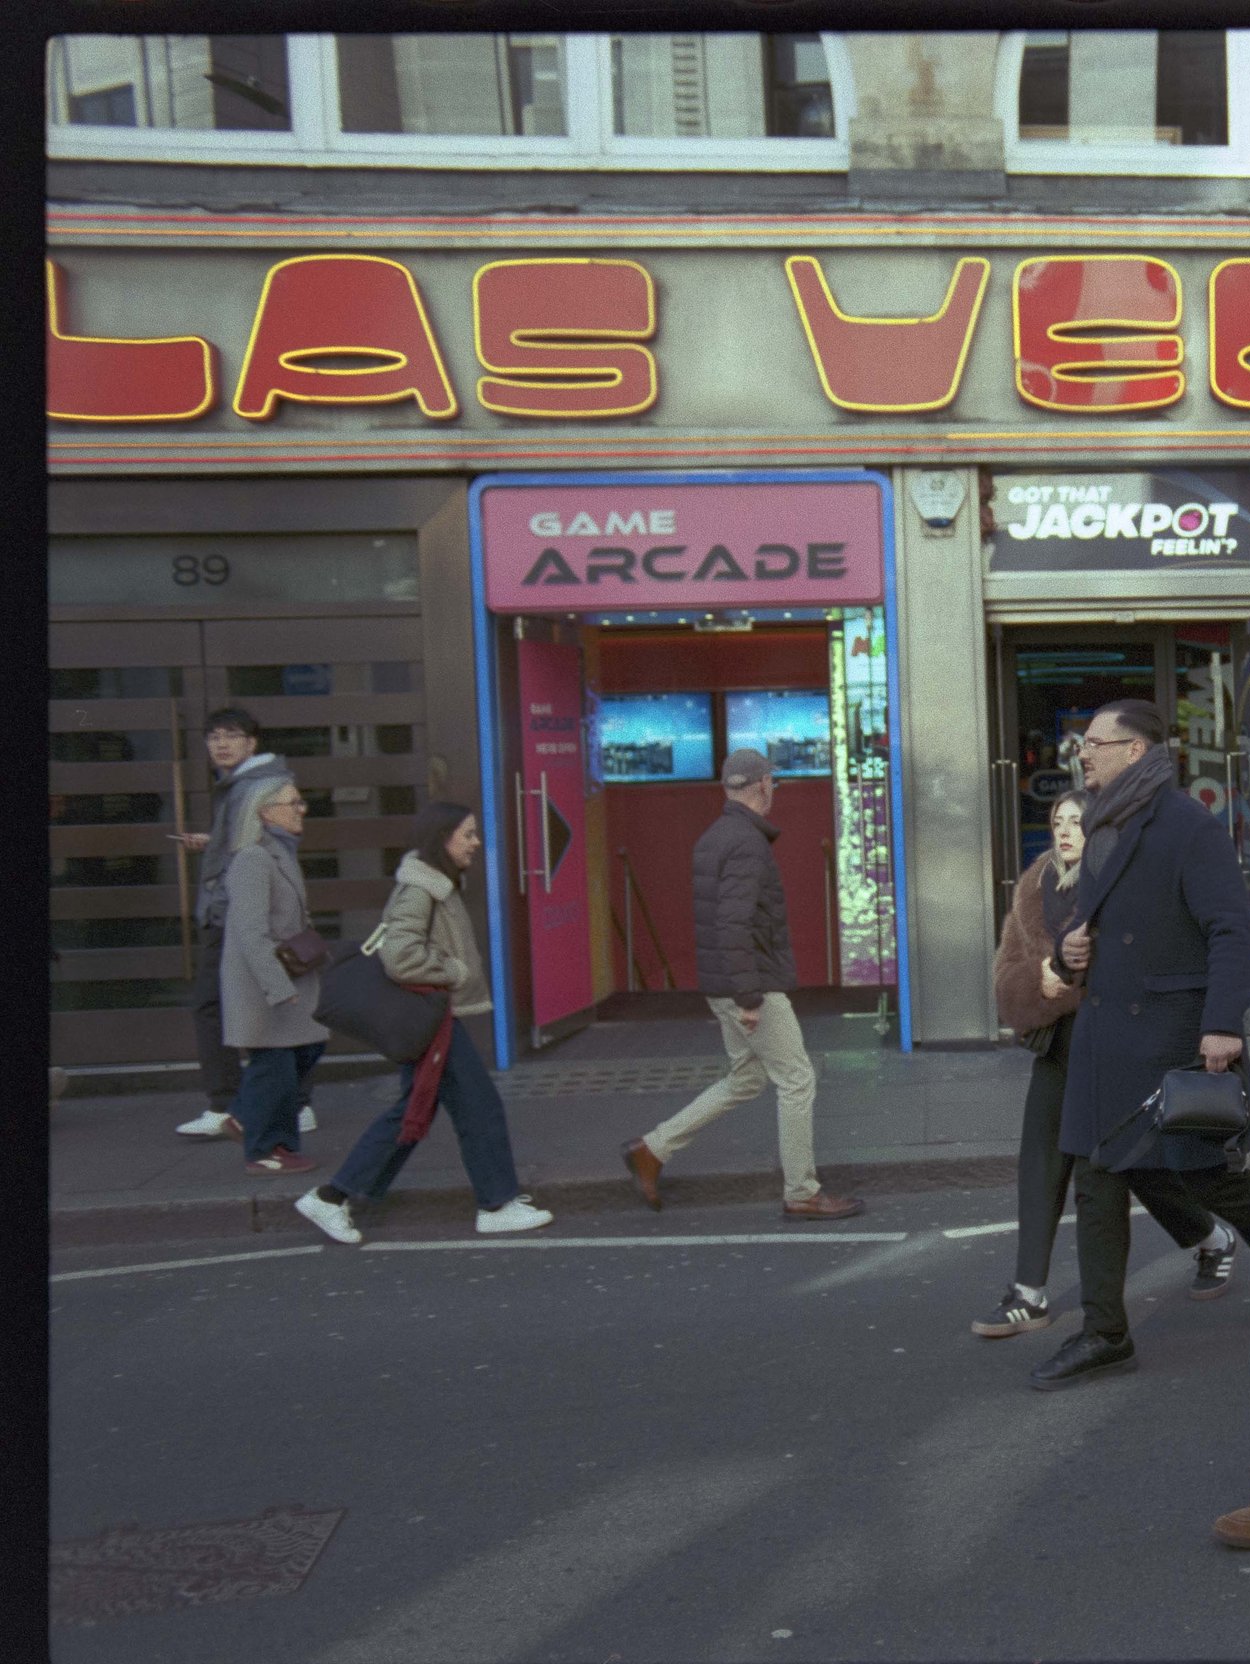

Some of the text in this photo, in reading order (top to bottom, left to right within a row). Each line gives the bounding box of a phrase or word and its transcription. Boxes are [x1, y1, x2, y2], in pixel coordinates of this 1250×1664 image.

[47, 252, 658, 422] LAS
[1008, 485, 1111, 503] GOT THAT
[529, 510, 677, 537] GAME
[1008, 502, 1239, 539] JACKPOT
[1150, 537, 1238, 556] FEELIN'?
[172, 554, 230, 587] 89
[520, 542, 848, 586] ARCADE
